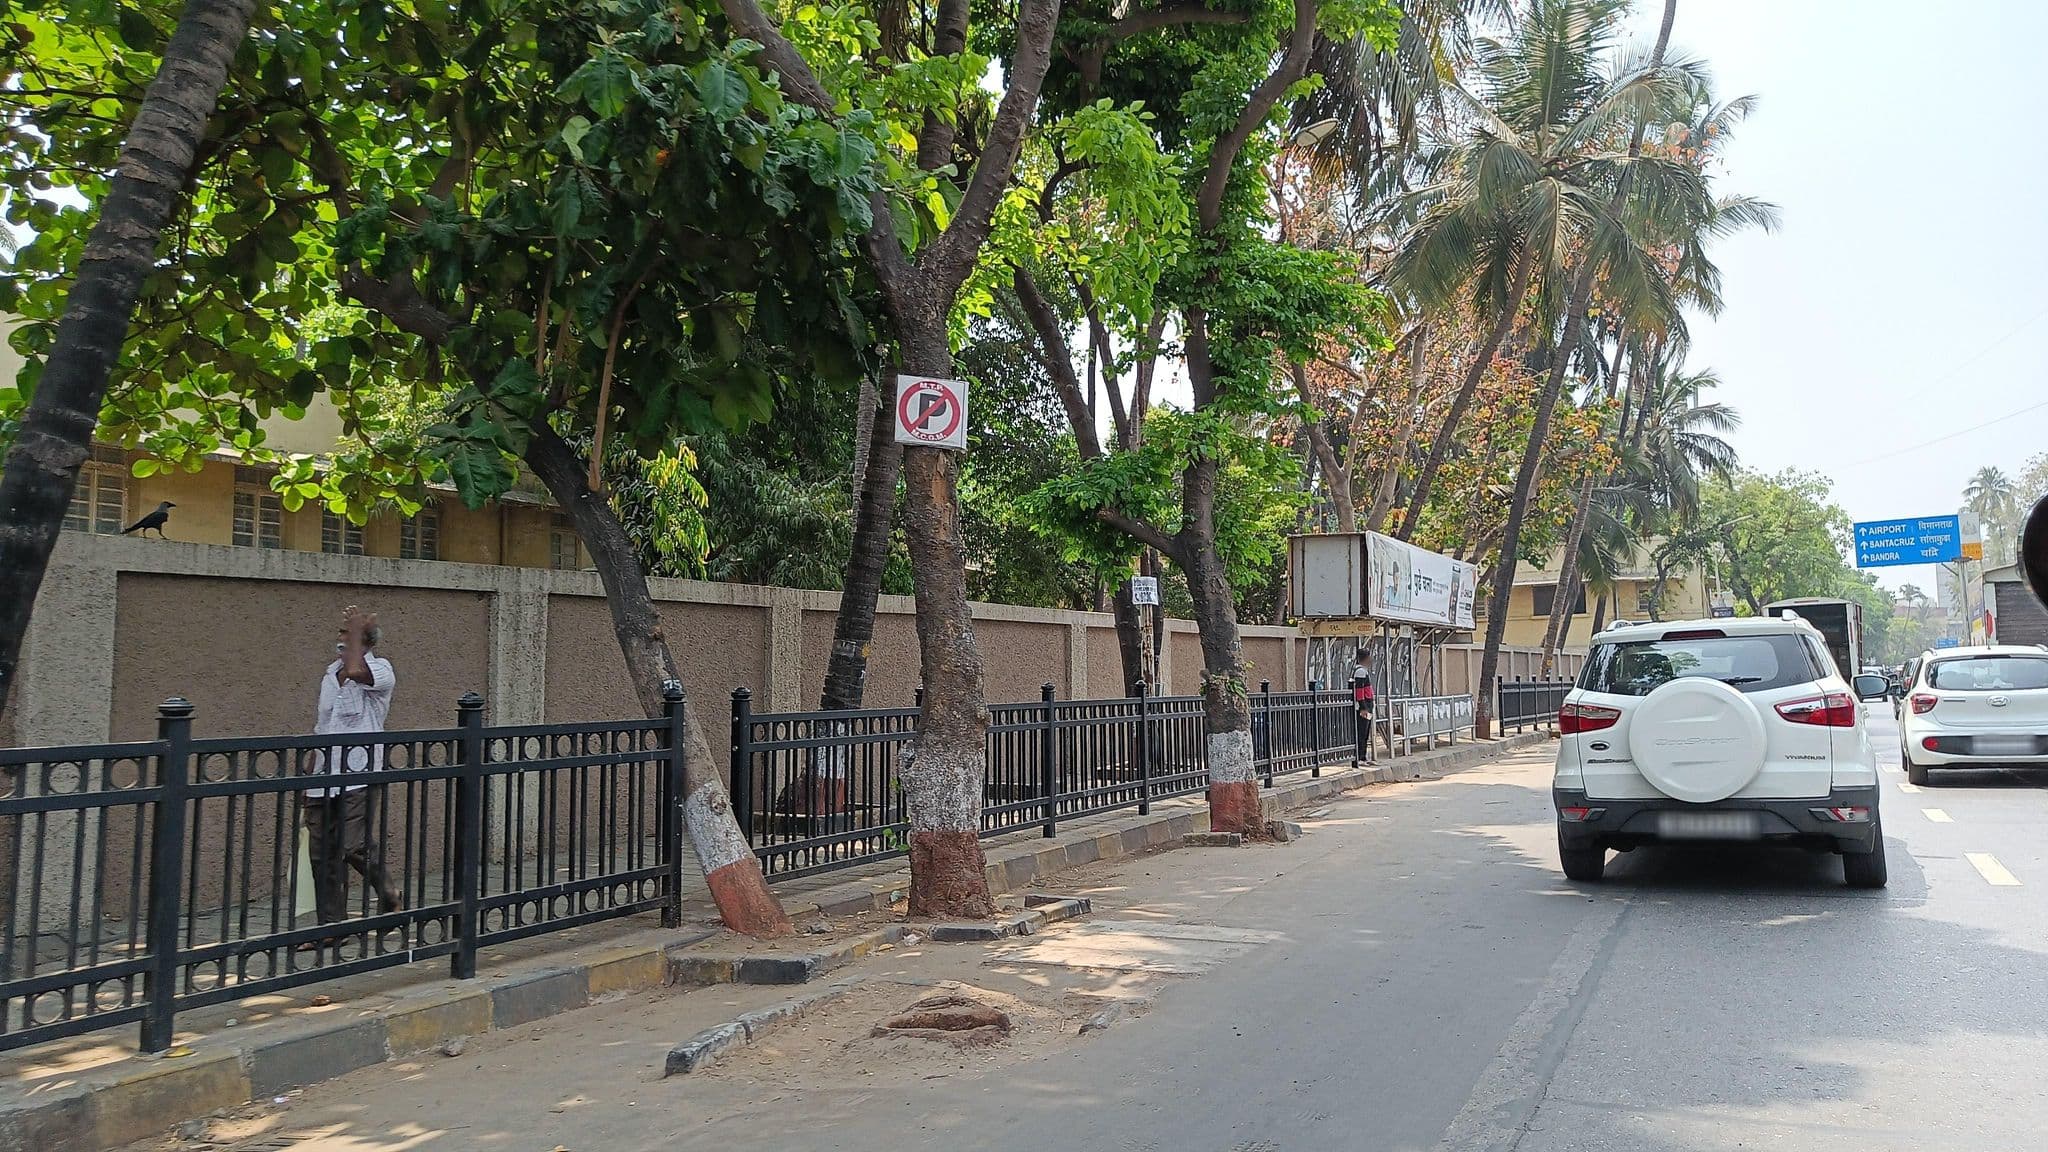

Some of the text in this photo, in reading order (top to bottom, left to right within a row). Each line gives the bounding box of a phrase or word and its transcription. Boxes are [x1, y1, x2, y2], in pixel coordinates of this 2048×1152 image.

[1868, 525, 1906, 535] AIRPORT
[1869, 537, 1915, 548] SANTACRUZ
[1870, 552, 1900, 561] BANDRA
